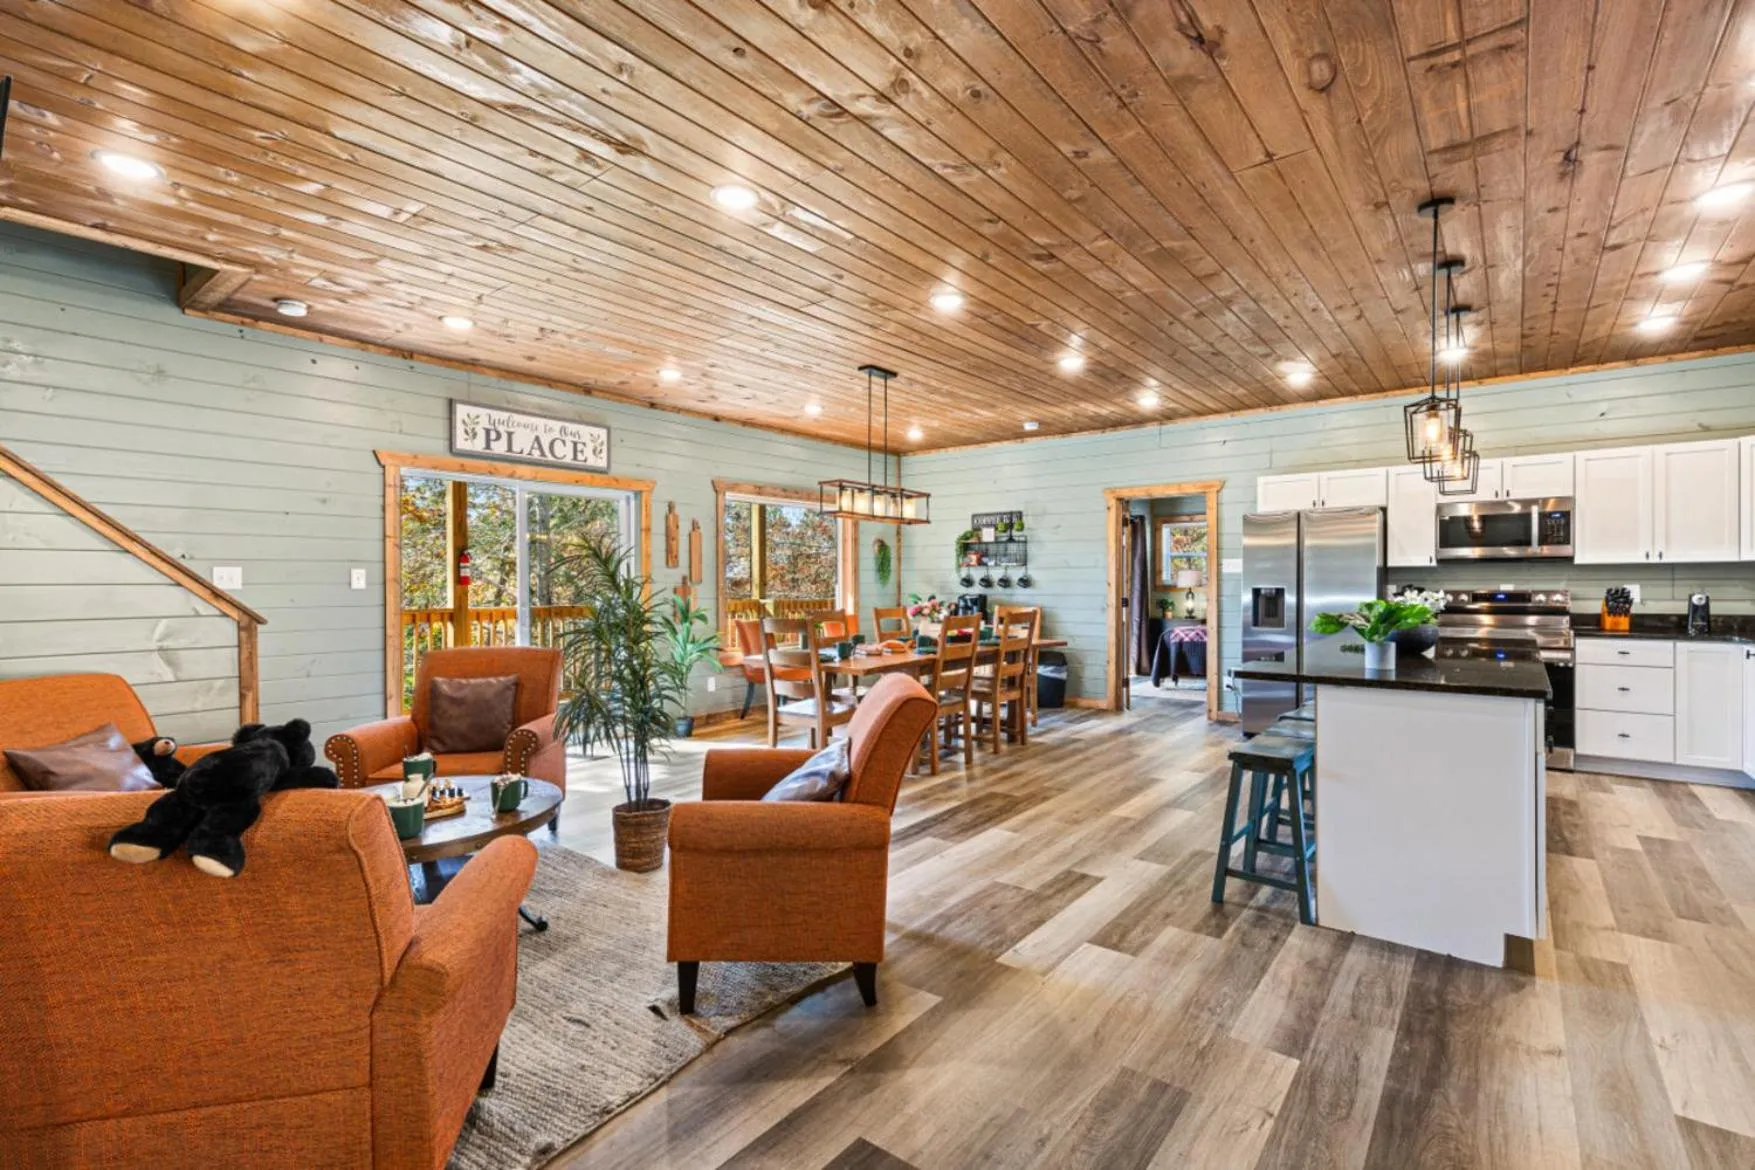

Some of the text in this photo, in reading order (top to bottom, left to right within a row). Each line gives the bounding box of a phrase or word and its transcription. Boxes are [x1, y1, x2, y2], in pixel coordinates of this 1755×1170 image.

[487, 413, 538, 431] Welcome
[544, 424, 555, 433] to
[483, 427, 588, 463] PLACE
